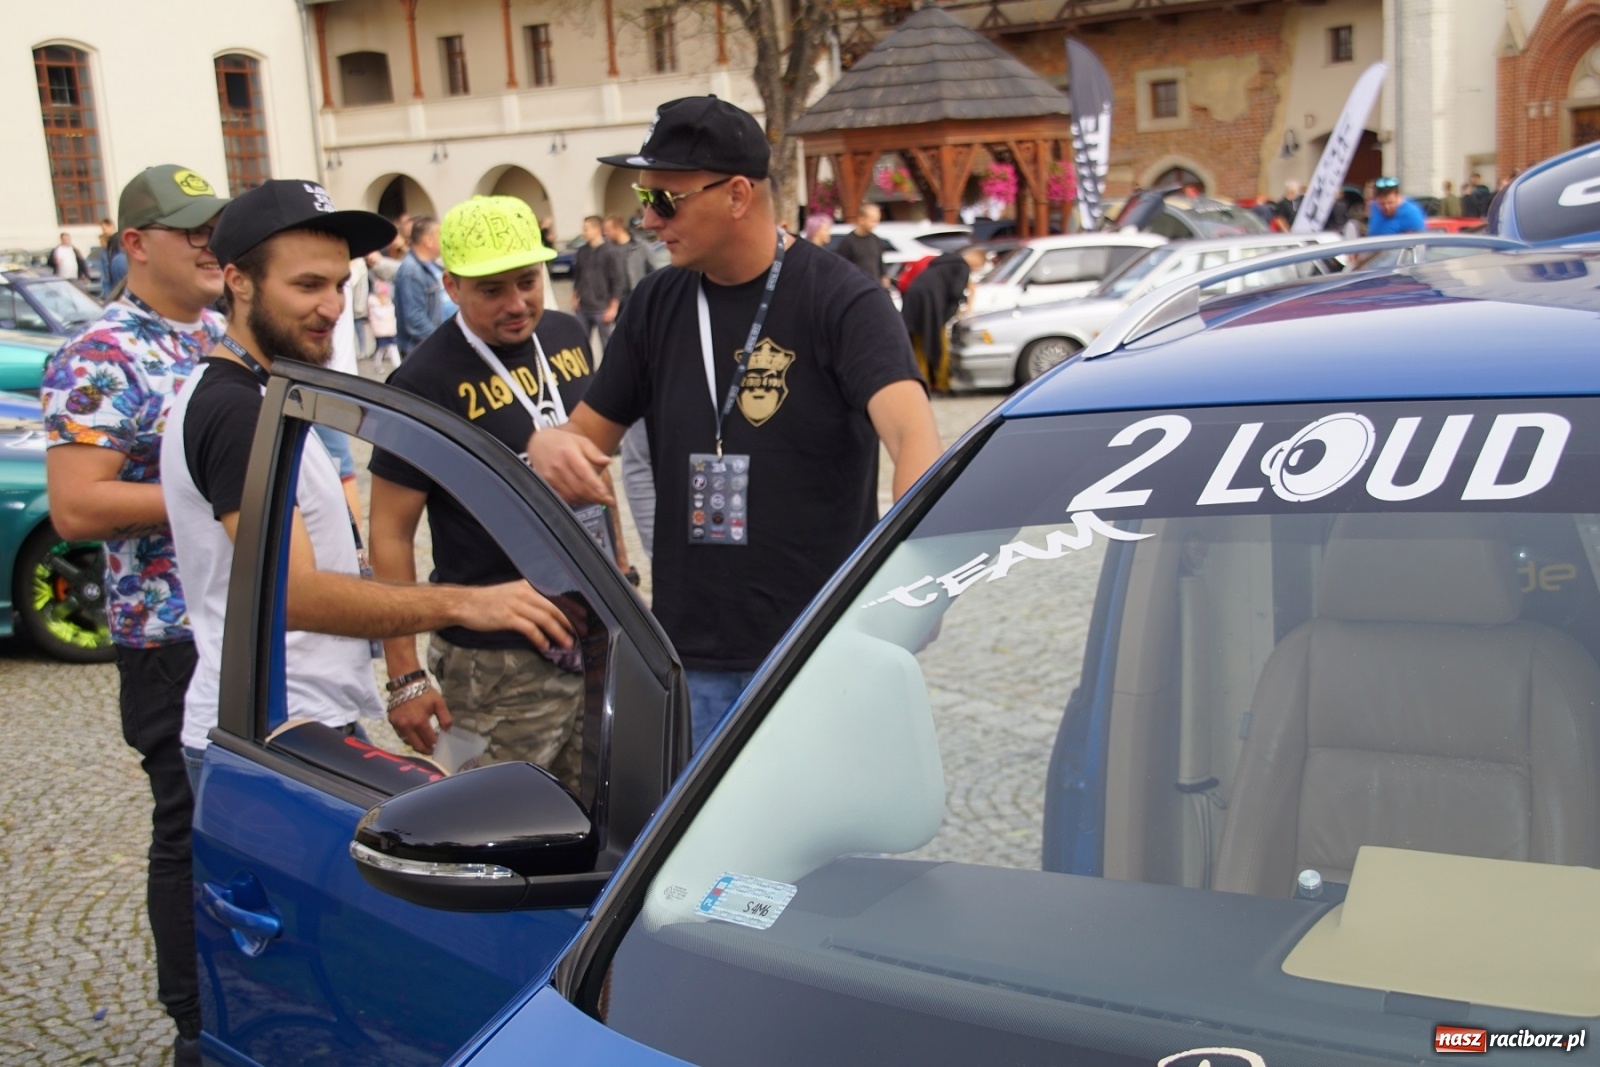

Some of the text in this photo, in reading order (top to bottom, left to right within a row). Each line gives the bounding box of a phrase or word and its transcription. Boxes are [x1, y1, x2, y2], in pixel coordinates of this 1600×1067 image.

[458, 381, 486, 420] 2
[549, 346, 590, 382] YOU
[1066, 412, 1572, 512] 2 LOUD
